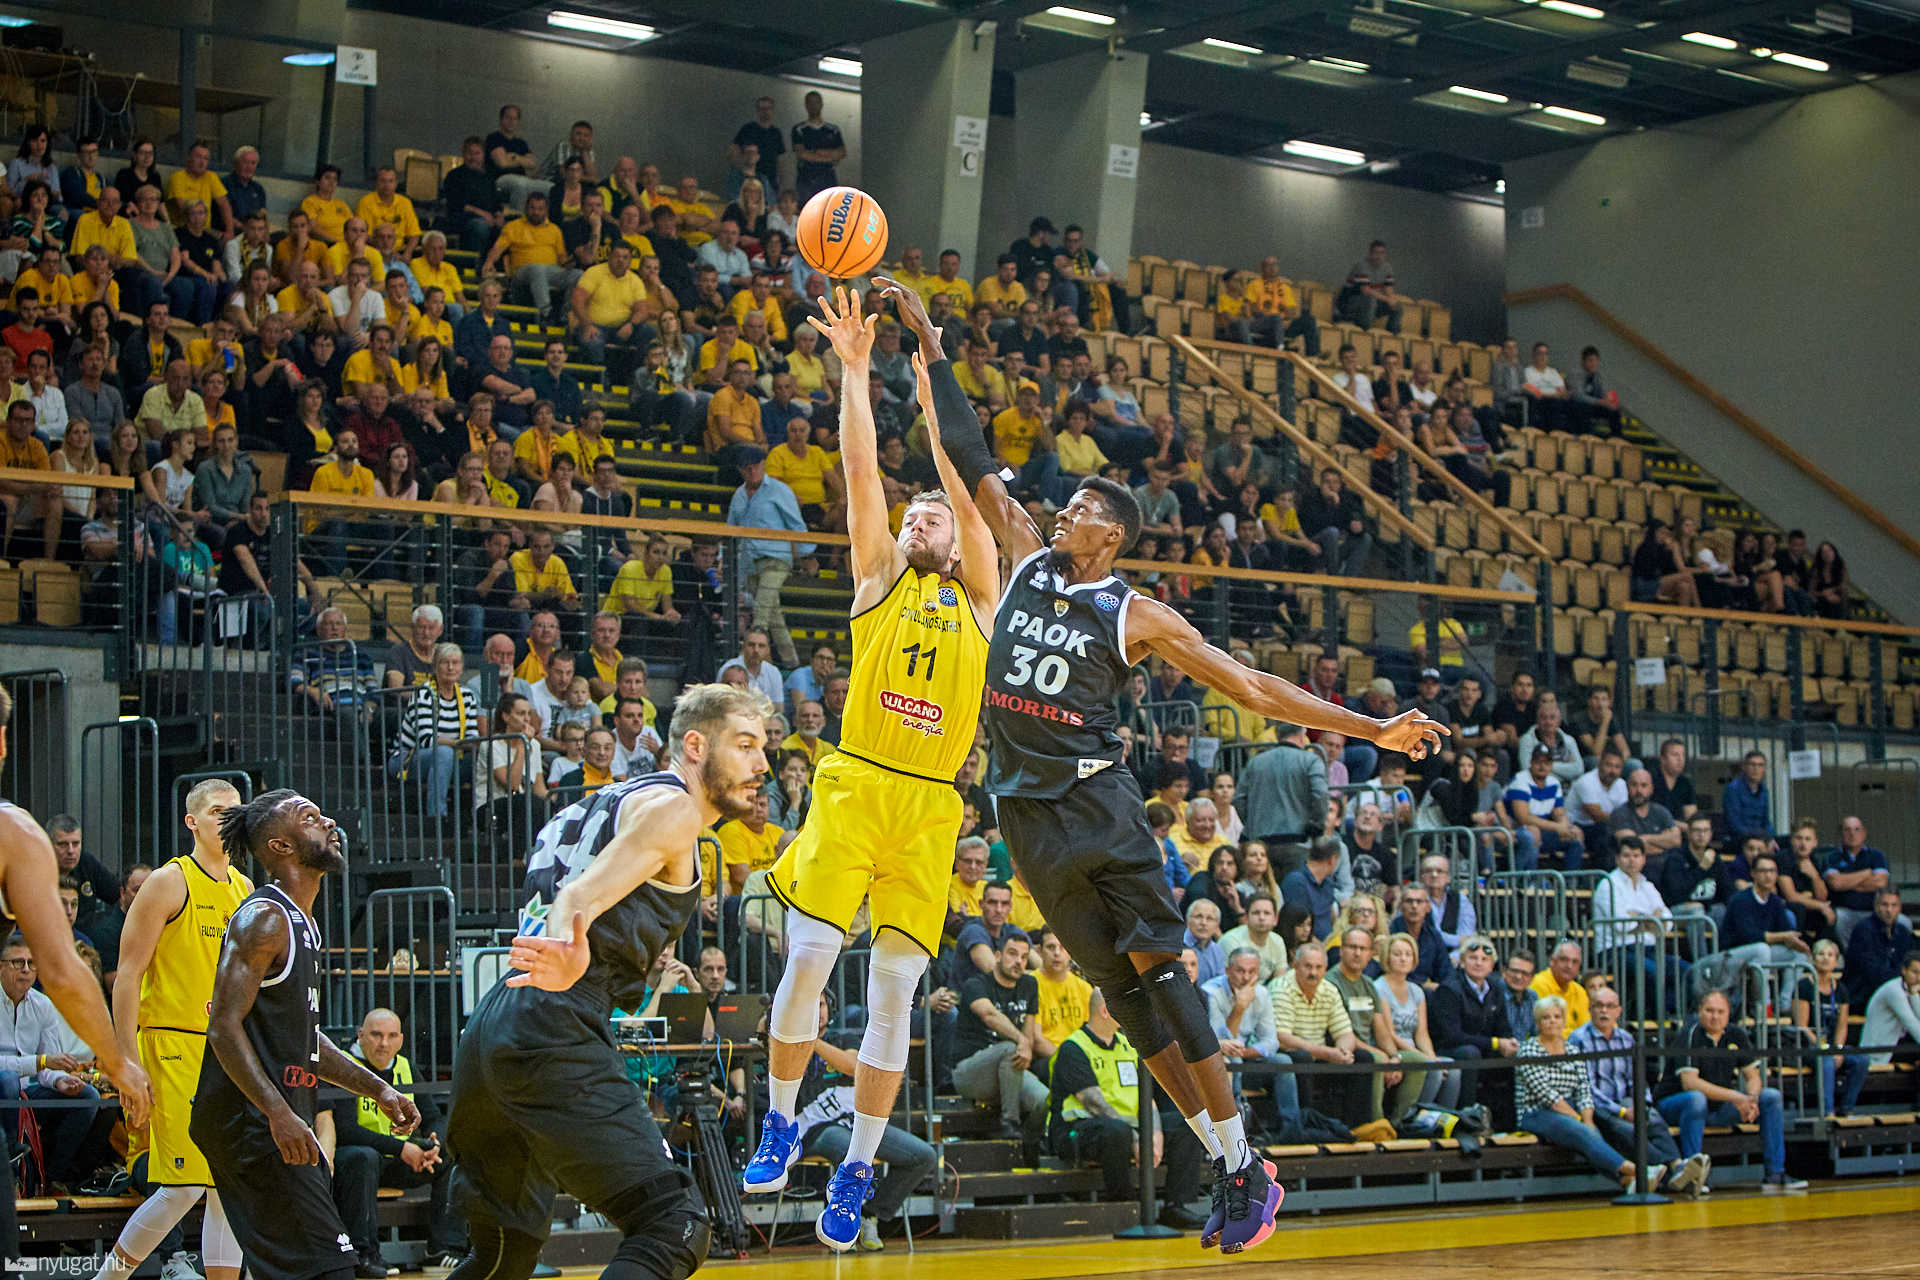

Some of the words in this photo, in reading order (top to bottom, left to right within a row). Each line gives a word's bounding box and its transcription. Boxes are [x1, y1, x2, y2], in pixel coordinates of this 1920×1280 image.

[963, 152, 977, 171] C
[826, 192, 855, 243] Wilson
[1006, 609, 1095, 659] PAOK
[901, 642, 937, 682] 11
[1003, 644, 1070, 696] 30
[989, 690, 1085, 727] MORRIS
